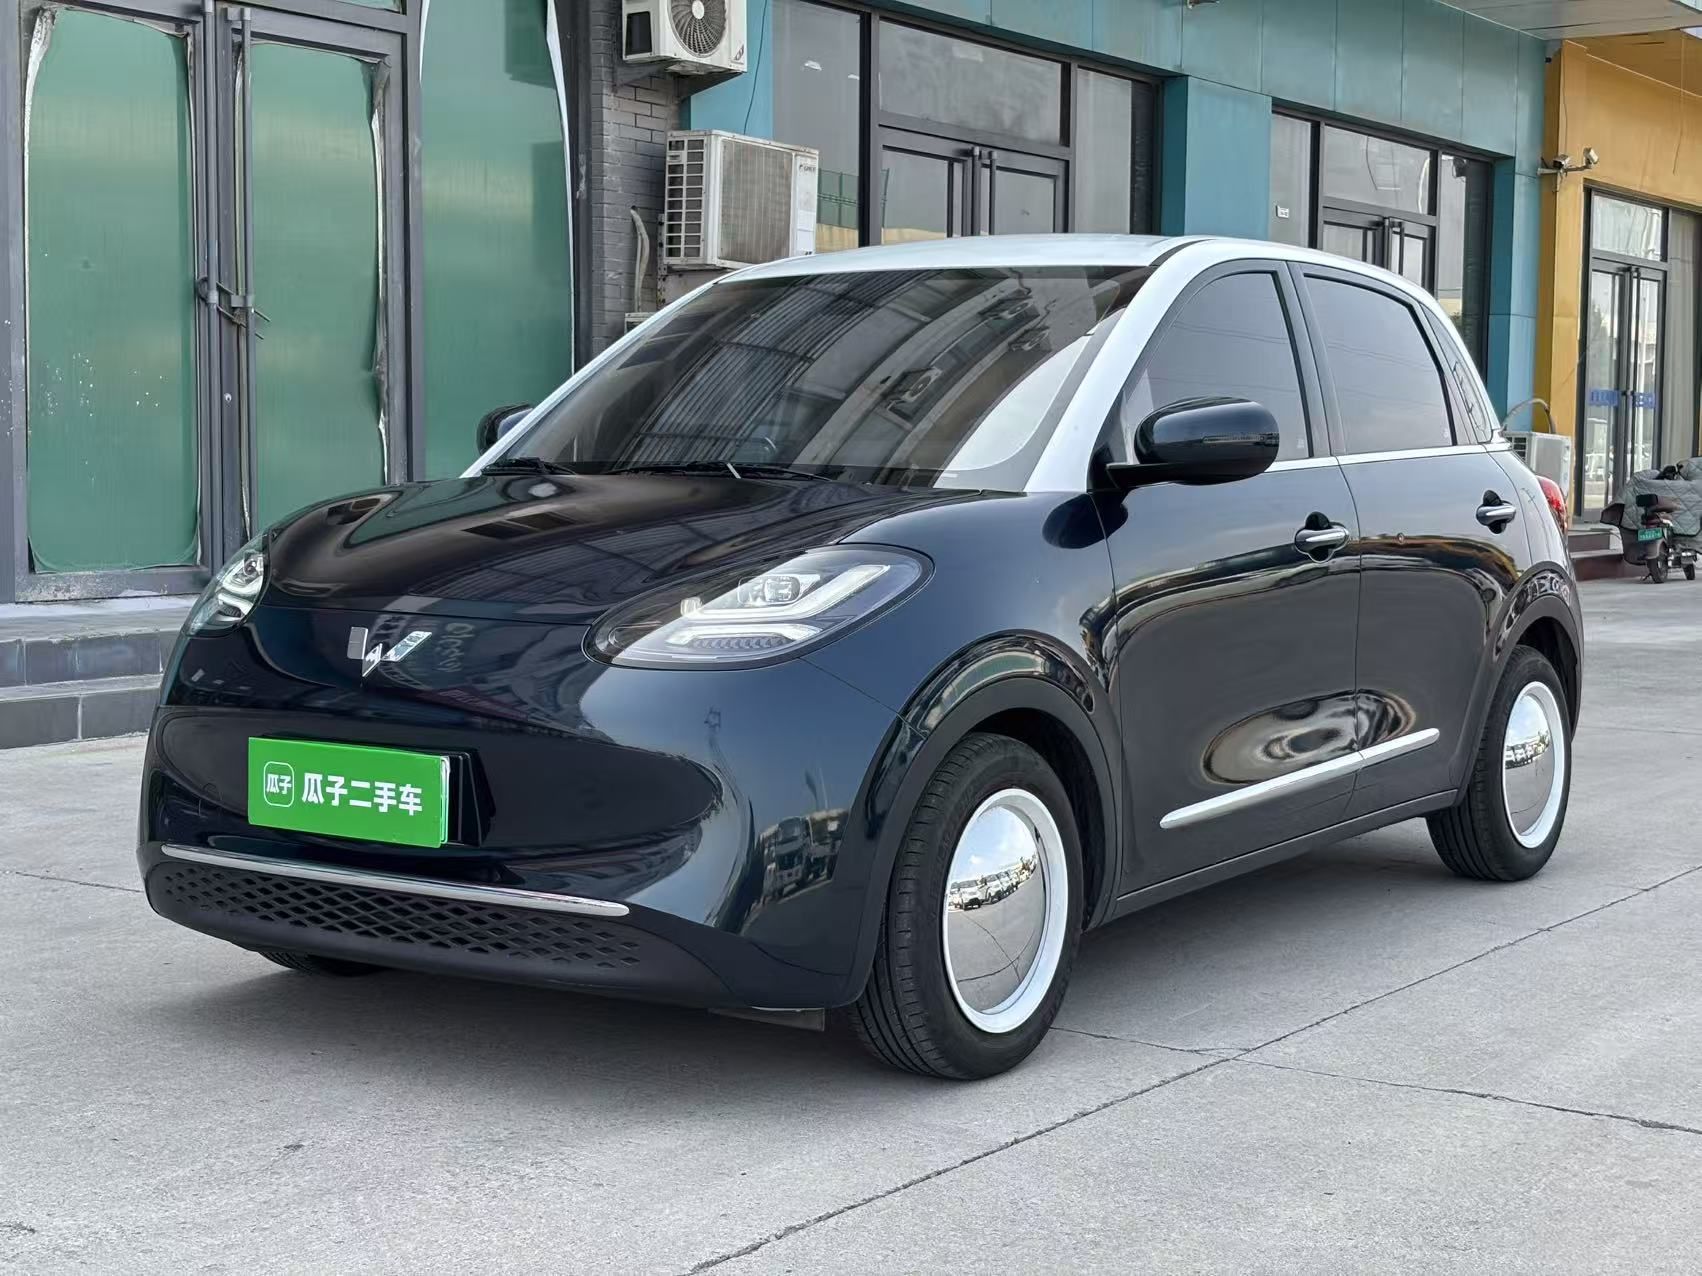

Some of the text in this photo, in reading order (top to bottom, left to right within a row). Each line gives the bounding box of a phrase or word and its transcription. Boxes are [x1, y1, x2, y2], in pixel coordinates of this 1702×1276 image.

[266, 773, 292, 795] 瓜子
[302, 772, 423, 816] 瓜子二手车
